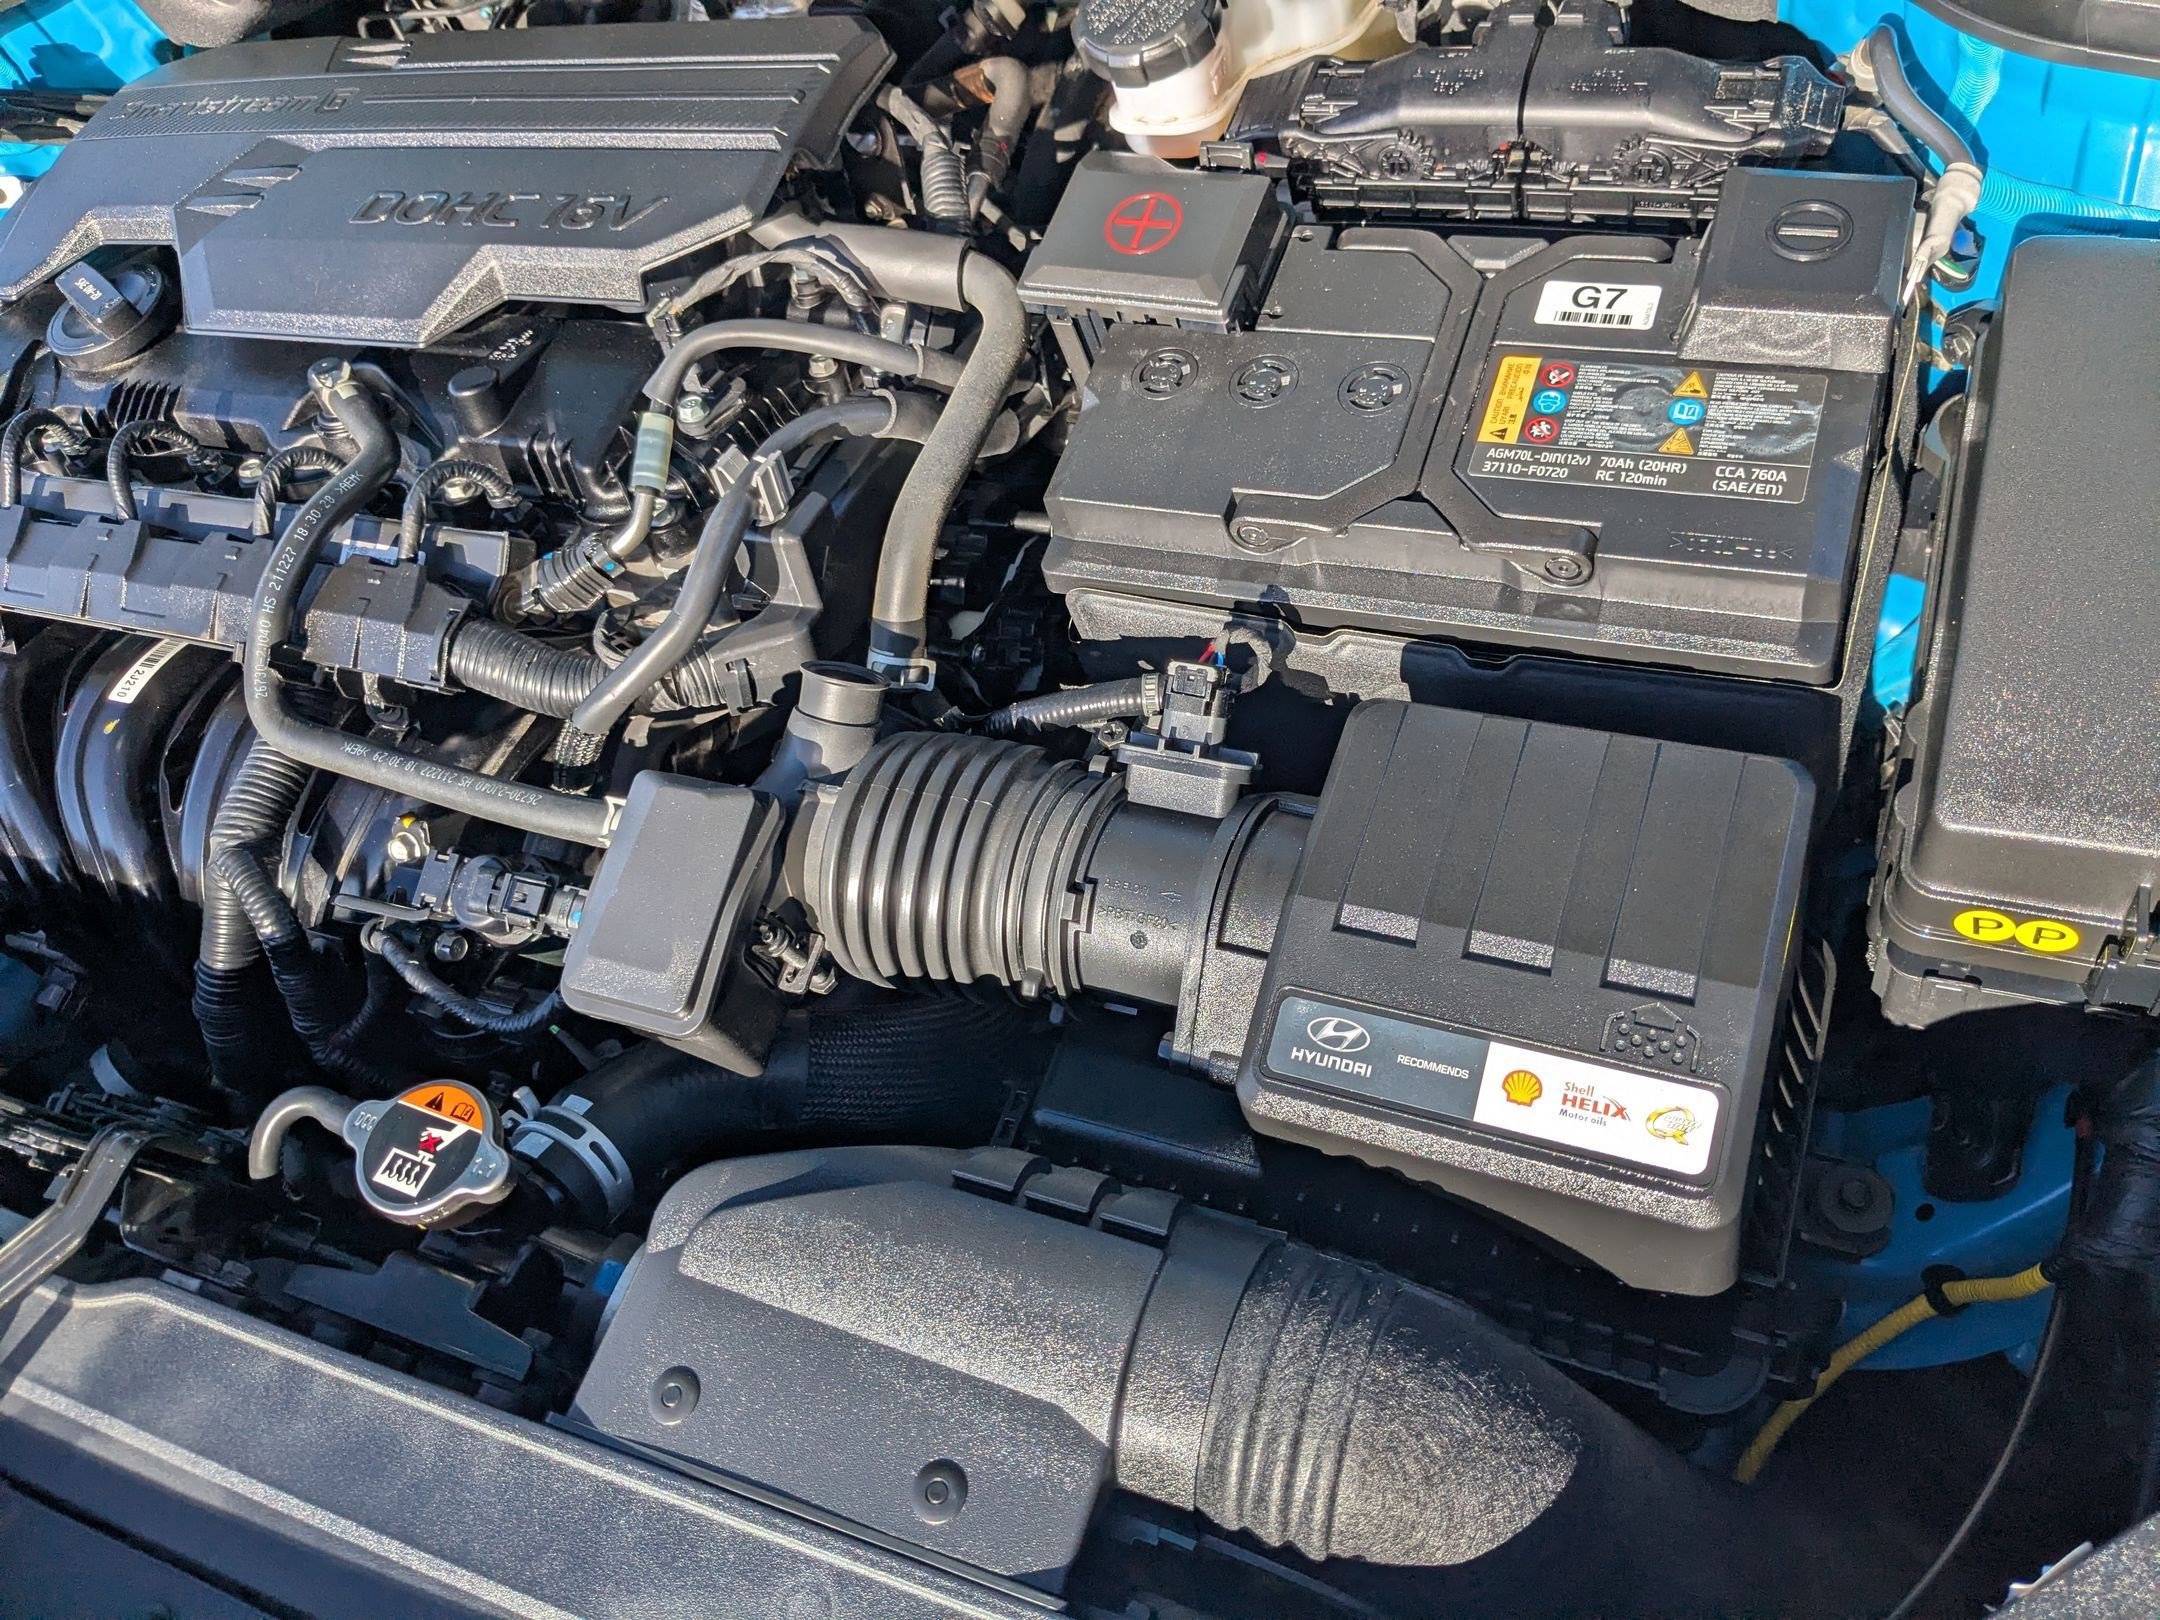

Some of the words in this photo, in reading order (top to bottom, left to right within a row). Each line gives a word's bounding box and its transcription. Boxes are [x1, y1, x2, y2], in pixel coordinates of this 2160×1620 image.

[349, 191, 540, 226] DOHC
[539, 194, 670, 231] 16V
[1572, 286, 1628, 309] G7
[1482, 461, 1569, 479] 37110-F0720
[1595, 469, 1614, 482] RC
[1620, 472, 1667, 487] 120min
[1712, 480, 1783, 496] (SAE/EN)
[1600, 456, 1634, 470] 70Ah
[1638, 458, 1687, 474] (20HR)
[1715, 465, 1745, 480] CCA
[1751, 468, 1788, 483] 760A
[269, 547, 297, 591] 211227
[263, 597, 277, 614] HS
[117, 669, 145, 698] 2J210
[420, 766, 455, 784] 211227
[458, 774, 471, 788] HS
[1973, 917, 2004, 935] P
[2032, 927, 2067, 945] P
[1290, 1046, 1372, 1078] HYUNDAI
[1397, 1055, 1470, 1080] RECOMMENDS
[1564, 1081, 1595, 1098] Shell
[1559, 1108, 1588, 1123] Motor
[1591, 1117, 1607, 1127] oils
[1561, 1093, 1630, 1121] HELIX
